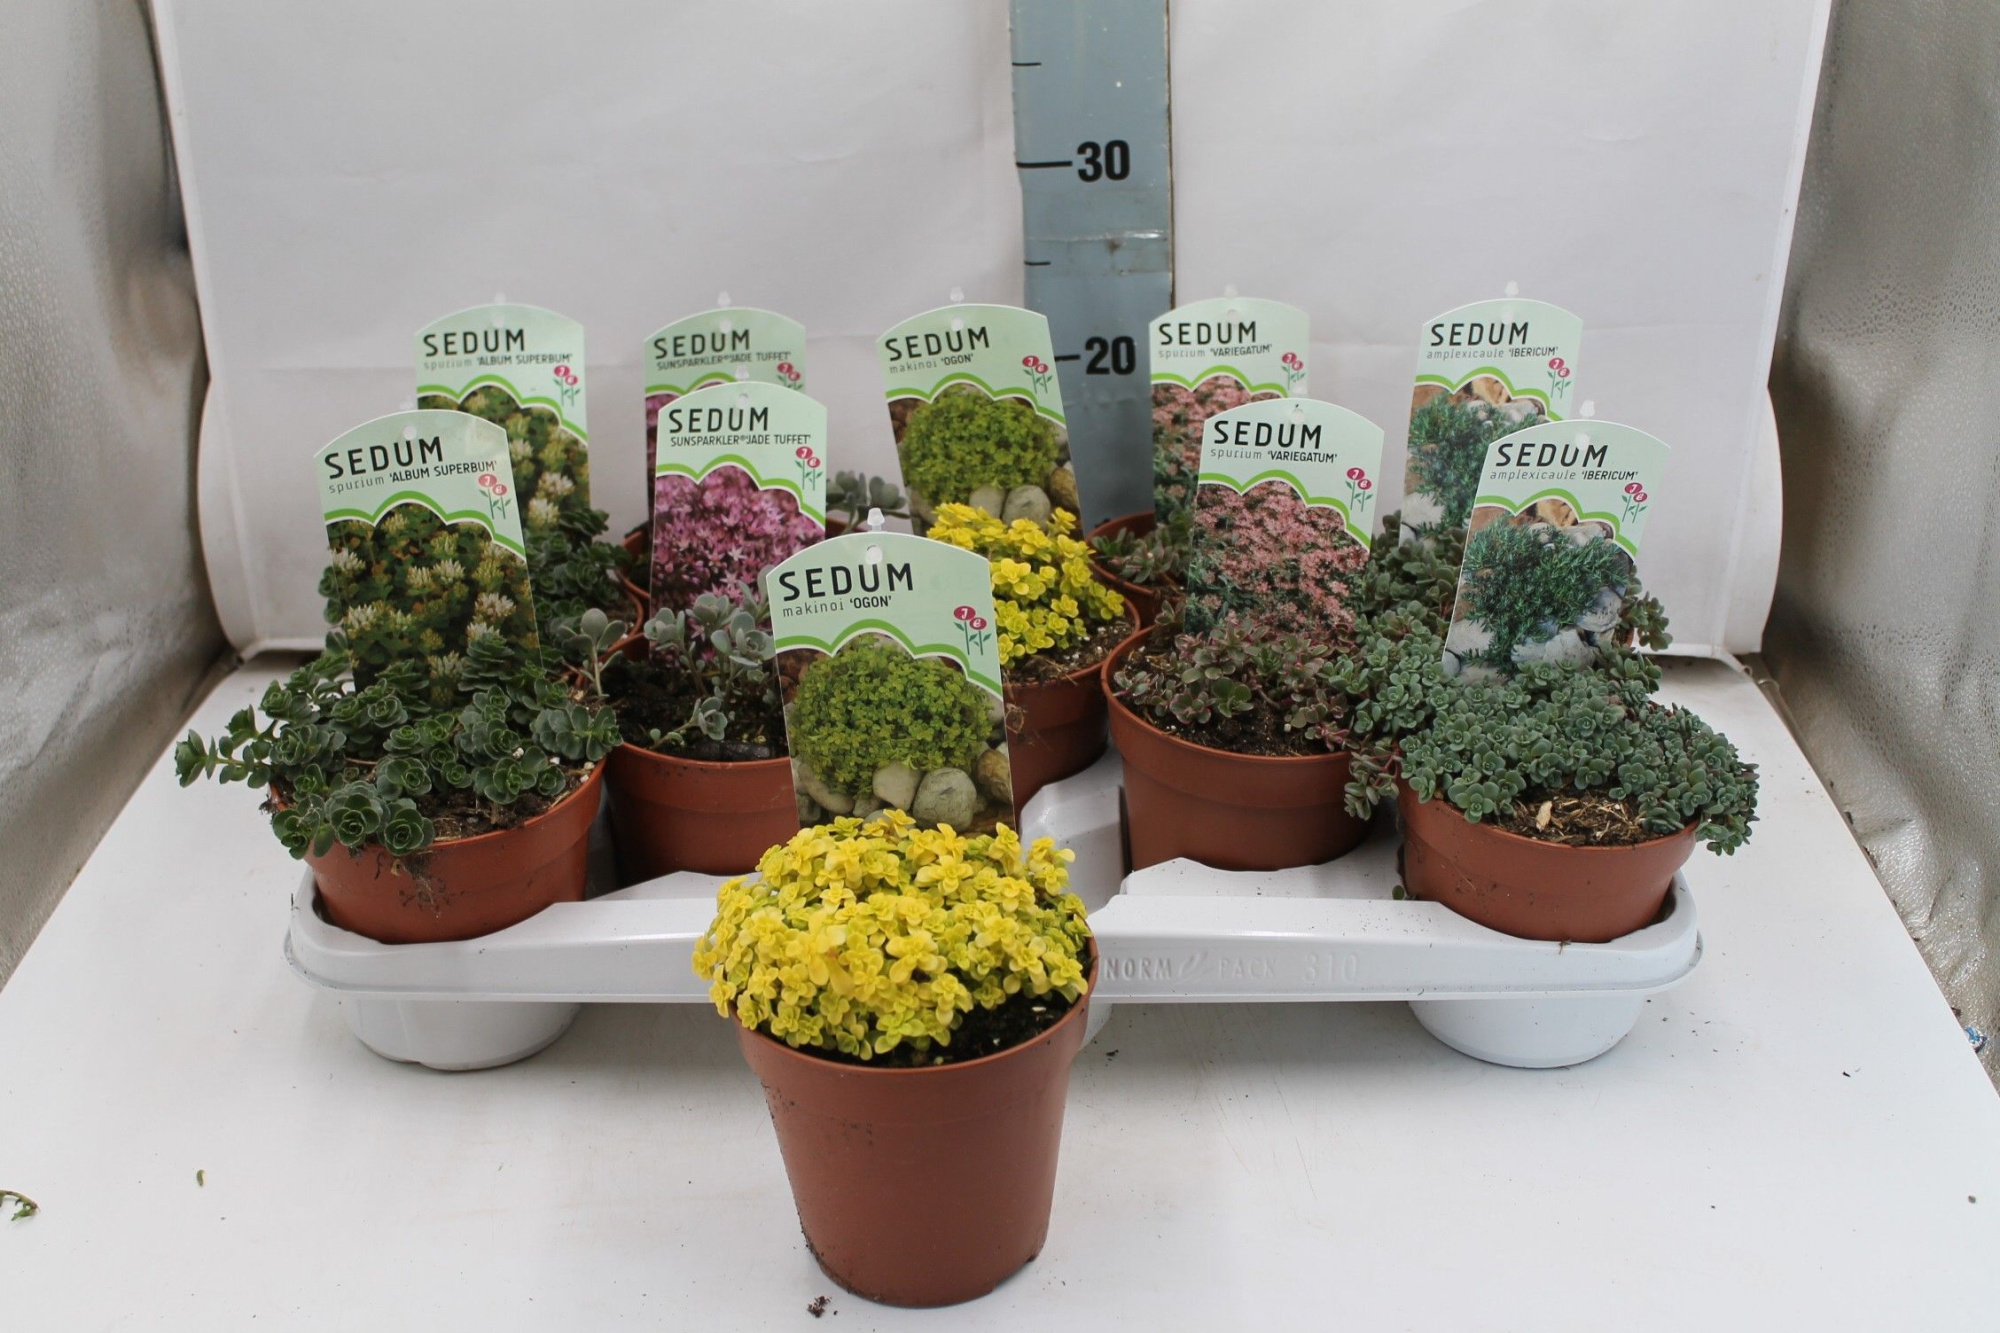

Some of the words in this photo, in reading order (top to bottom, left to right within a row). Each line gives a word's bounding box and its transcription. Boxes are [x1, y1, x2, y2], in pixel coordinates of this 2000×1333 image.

[1077, 139, 1130, 183] 30
[423, 329, 525, 357] SEDUM
[654, 329, 750, 359] SEDUM
[885, 326, 990, 362] SEDUM
[1158, 321, 1256, 345] SEDUM
[1430, 322, 1529, 346] SEDUM
[424, 359, 472, 371] spurium
[890, 360, 937, 374] makinoi
[941, 353, 974, 366] 'OGON'
[1085, 335, 1136, 376] 20
[1158, 349, 1205, 359] spurium
[1427, 348, 1504, 361] amplexicaule
[669, 407, 768, 433] SEDUM
[1213, 420, 1322, 449] SEDUM
[324, 436, 443, 479] SEDUM
[1210, 448, 1262, 460] spurium
[1267, 450, 1337, 464] 'VARIEGATUM'
[1495, 443, 1608, 468] SEDUM
[329, 475, 385, 495] spurium
[389, 467, 430, 483] 'ALBUM
[434, 460, 497, 477] SUPERBUM'
[1490, 469, 1576, 482] amplexicaule
[1581, 470, 1639, 481] 'IBERICUM'
[779, 562, 913, 602] SEDUM
[782, 598, 844, 617] makinoi
[850, 595, 892, 609] 'OGON'
[1102, 957, 1172, 981] NORM
[1218, 957, 1277, 980] PACK
